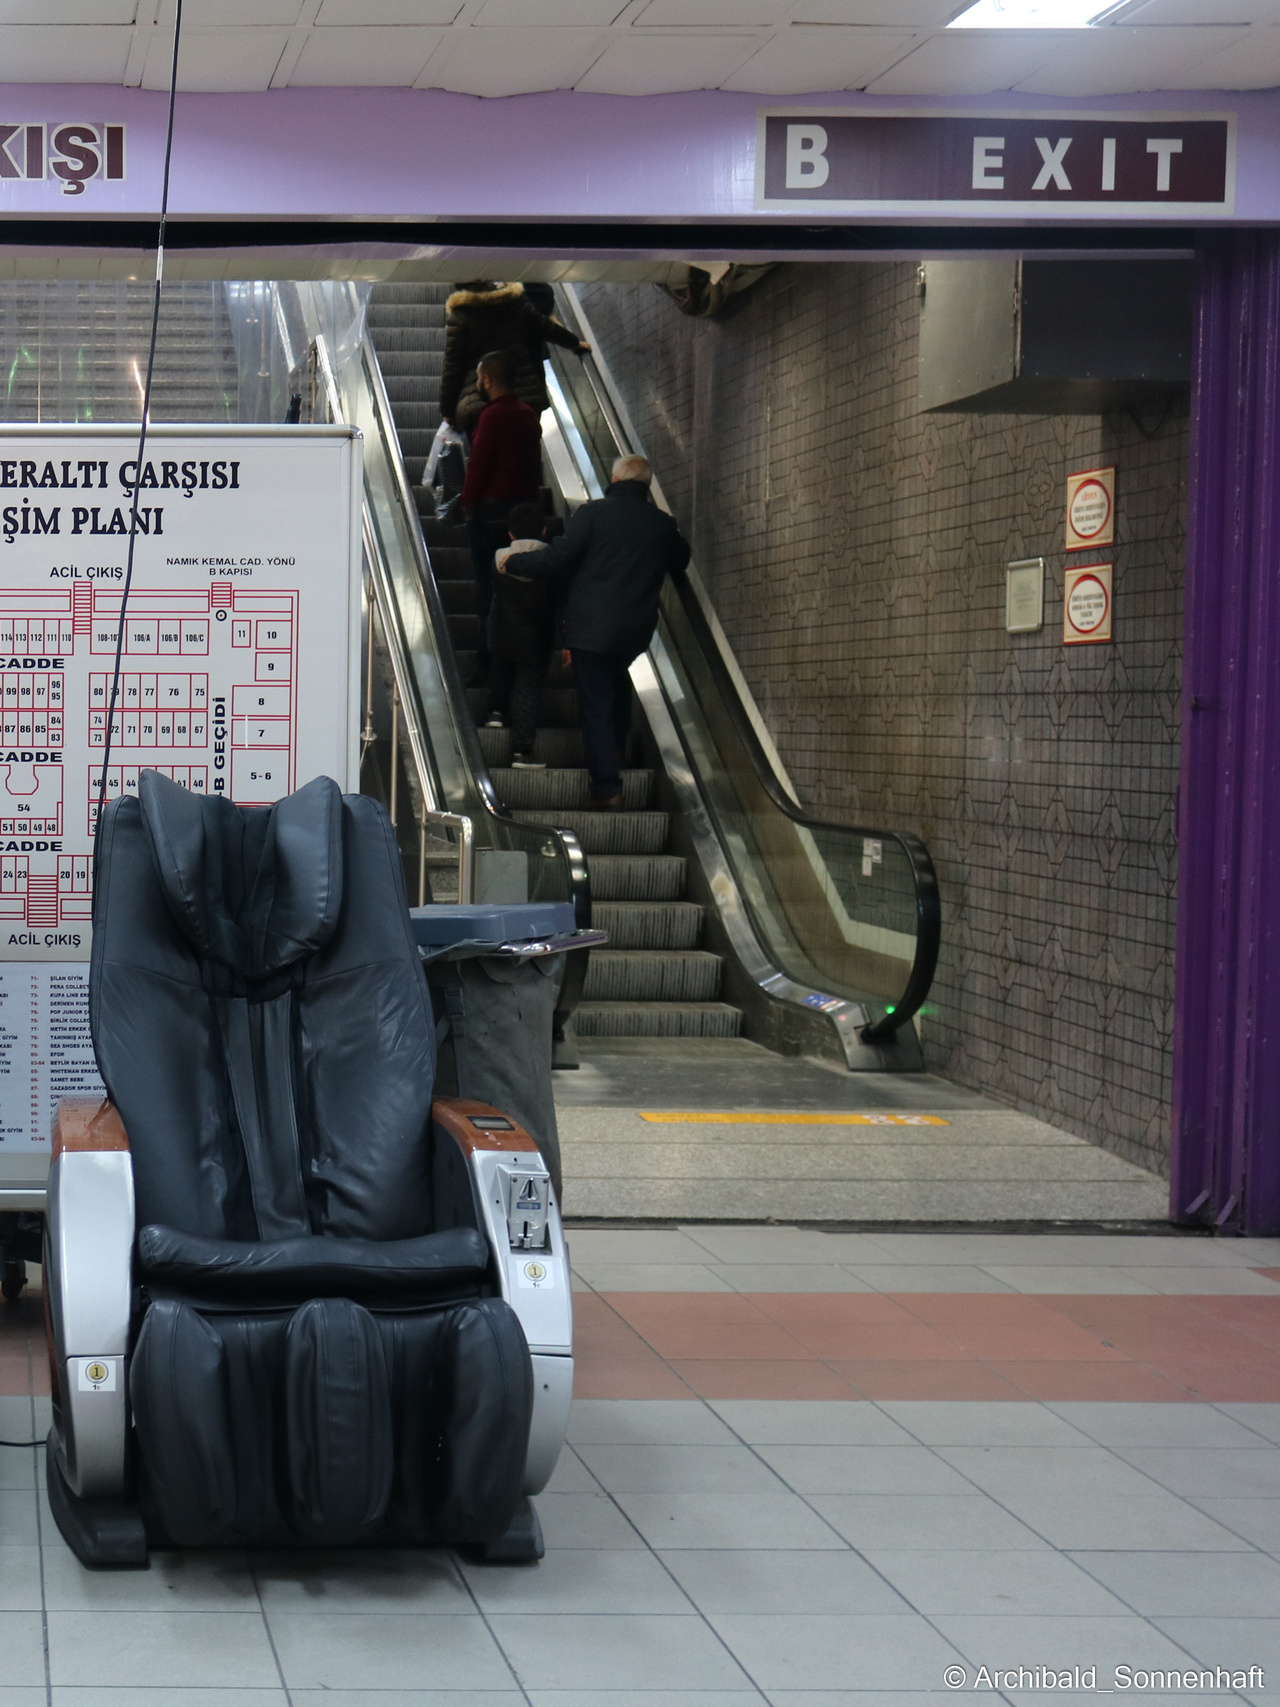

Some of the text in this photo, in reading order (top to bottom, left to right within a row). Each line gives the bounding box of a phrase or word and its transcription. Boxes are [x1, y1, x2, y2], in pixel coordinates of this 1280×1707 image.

[785, 124, 1183, 191] B EXIT
[119, 461, 240, 498] ÇARŞISI
[71, 507, 164, 535] PLANI
[50, 565, 122, 580] ACİL ÇIKIŞ
[186, 634, 203, 642] 106/C
[20, 725, 31, 733] 86
[212, 698, 227, 769] GEÇİDİ
[92, 779, 102, 787] 46
[8, 932, 80, 948] ACİL ÇIKIŞ
